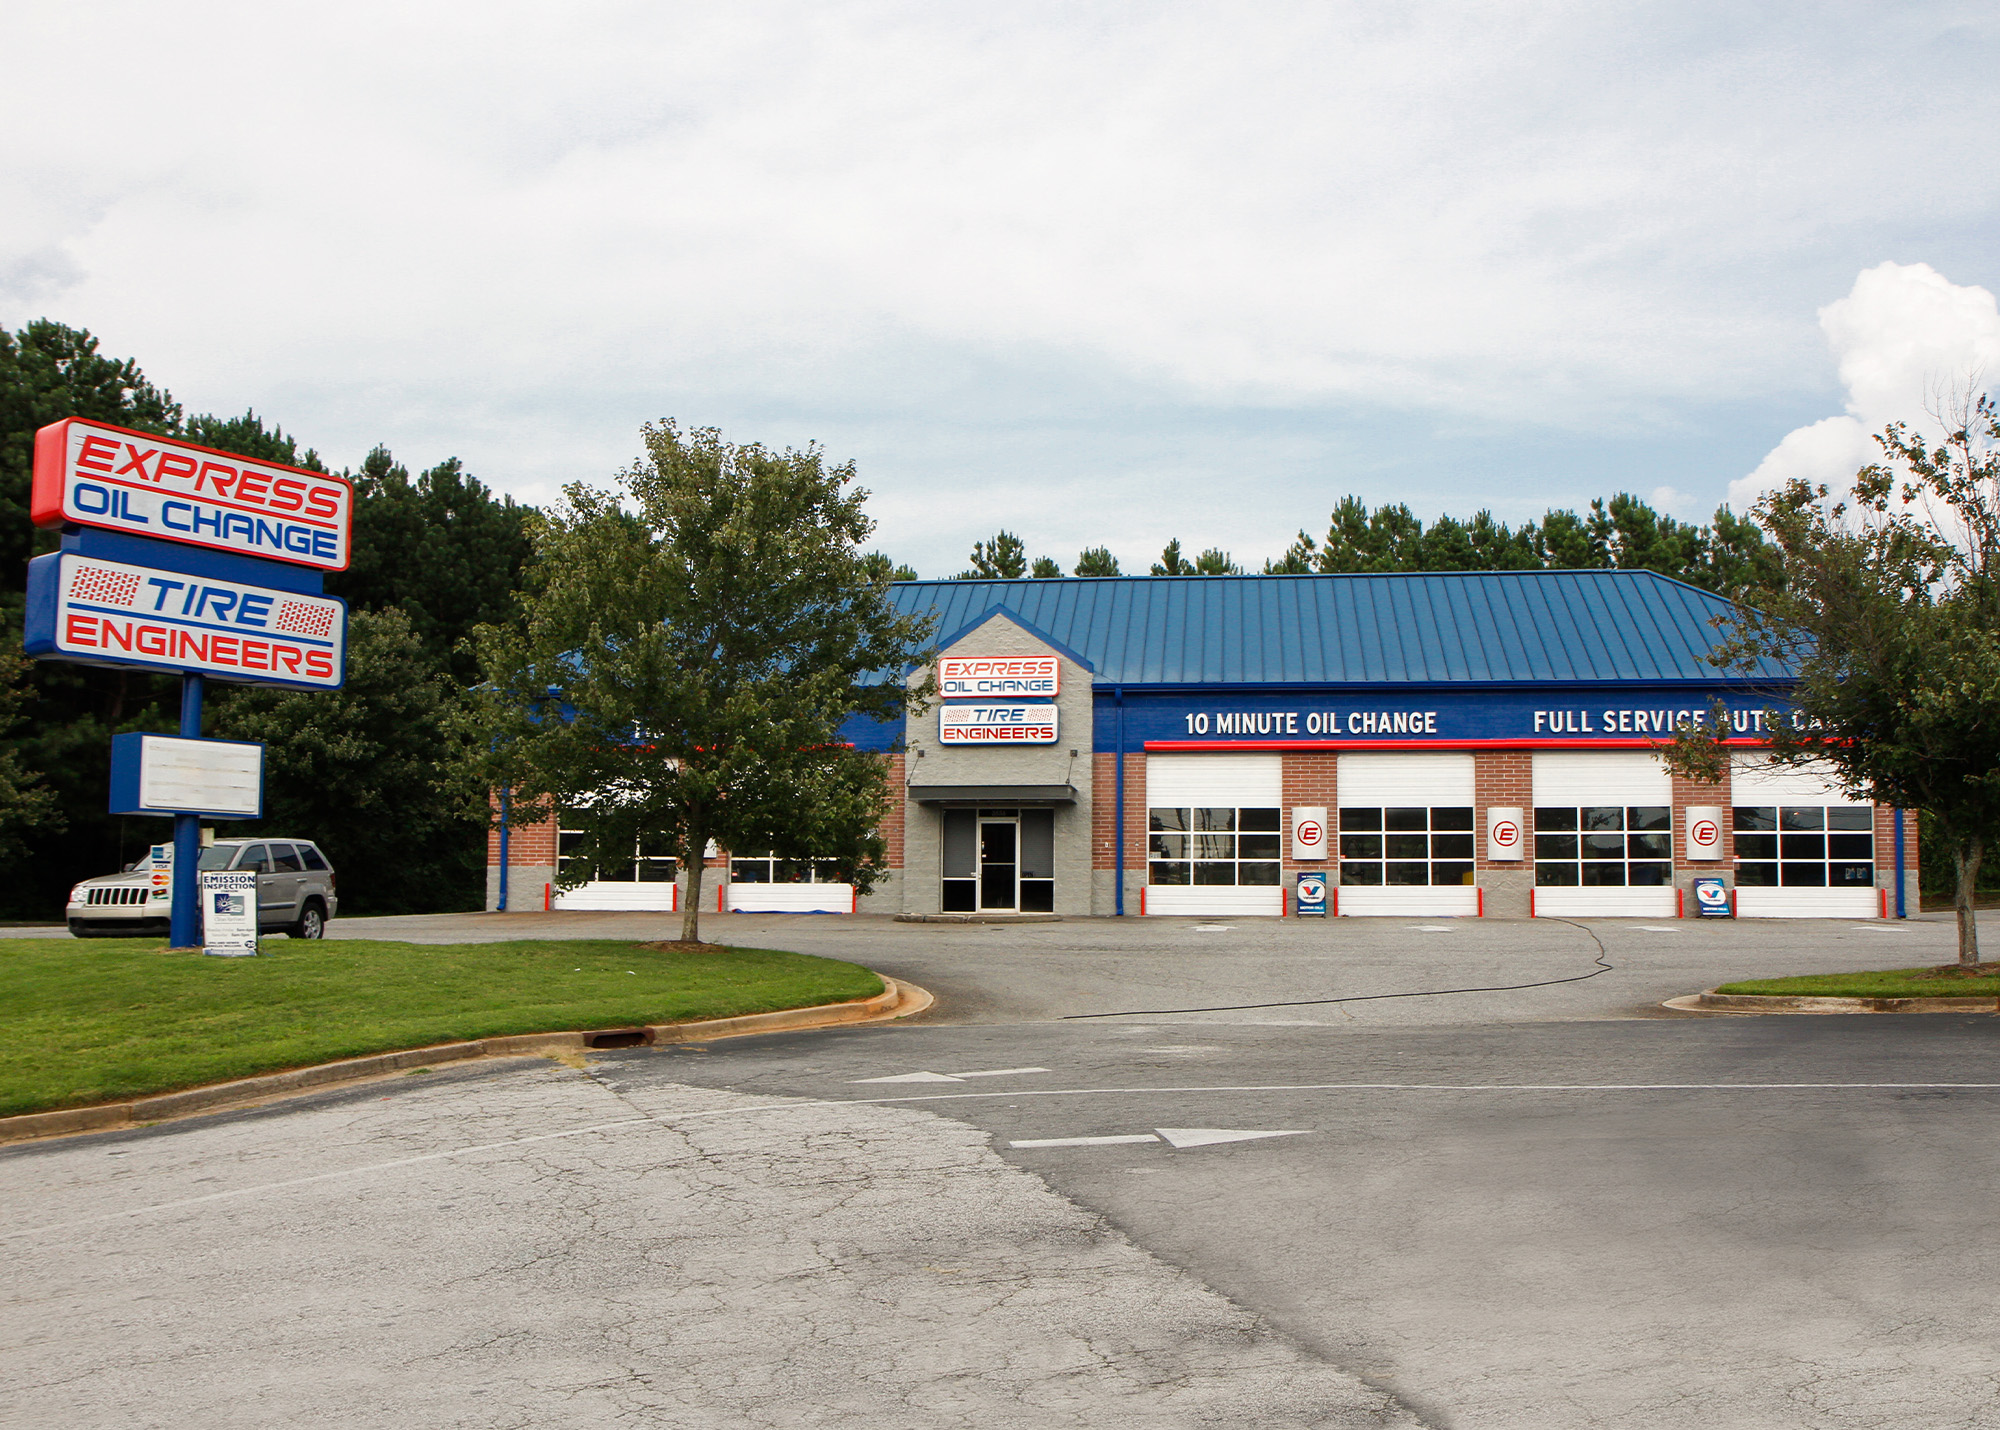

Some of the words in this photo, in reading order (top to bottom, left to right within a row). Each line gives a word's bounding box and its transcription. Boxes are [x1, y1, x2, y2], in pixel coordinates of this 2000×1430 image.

[77, 435, 343, 518] EXPRESS
[73, 483, 149, 525] OIL
[162, 501, 338, 560] CHANGE
[148, 577, 275, 627] TIRE
[66, 614, 333, 678] ENGINEERS
[944, 661, 1054, 676] EXPRESS
[943, 681, 973, 692] OIL
[977, 680, 1054, 692] CHANGE
[973, 708, 1026, 722] TIRE
[1185, 713, 1209, 735] 10
[1217, 712, 1299, 734] MINUTE
[1306, 711, 1342, 734] OIL
[1347, 711, 1438, 734] CHANGE
[1533, 710, 1594, 733] FULL
[1602, 710, 1706, 733] SERVICE
[943, 727, 1054, 740] ENGINEERS
[204, 876, 255, 884] EMISSION
